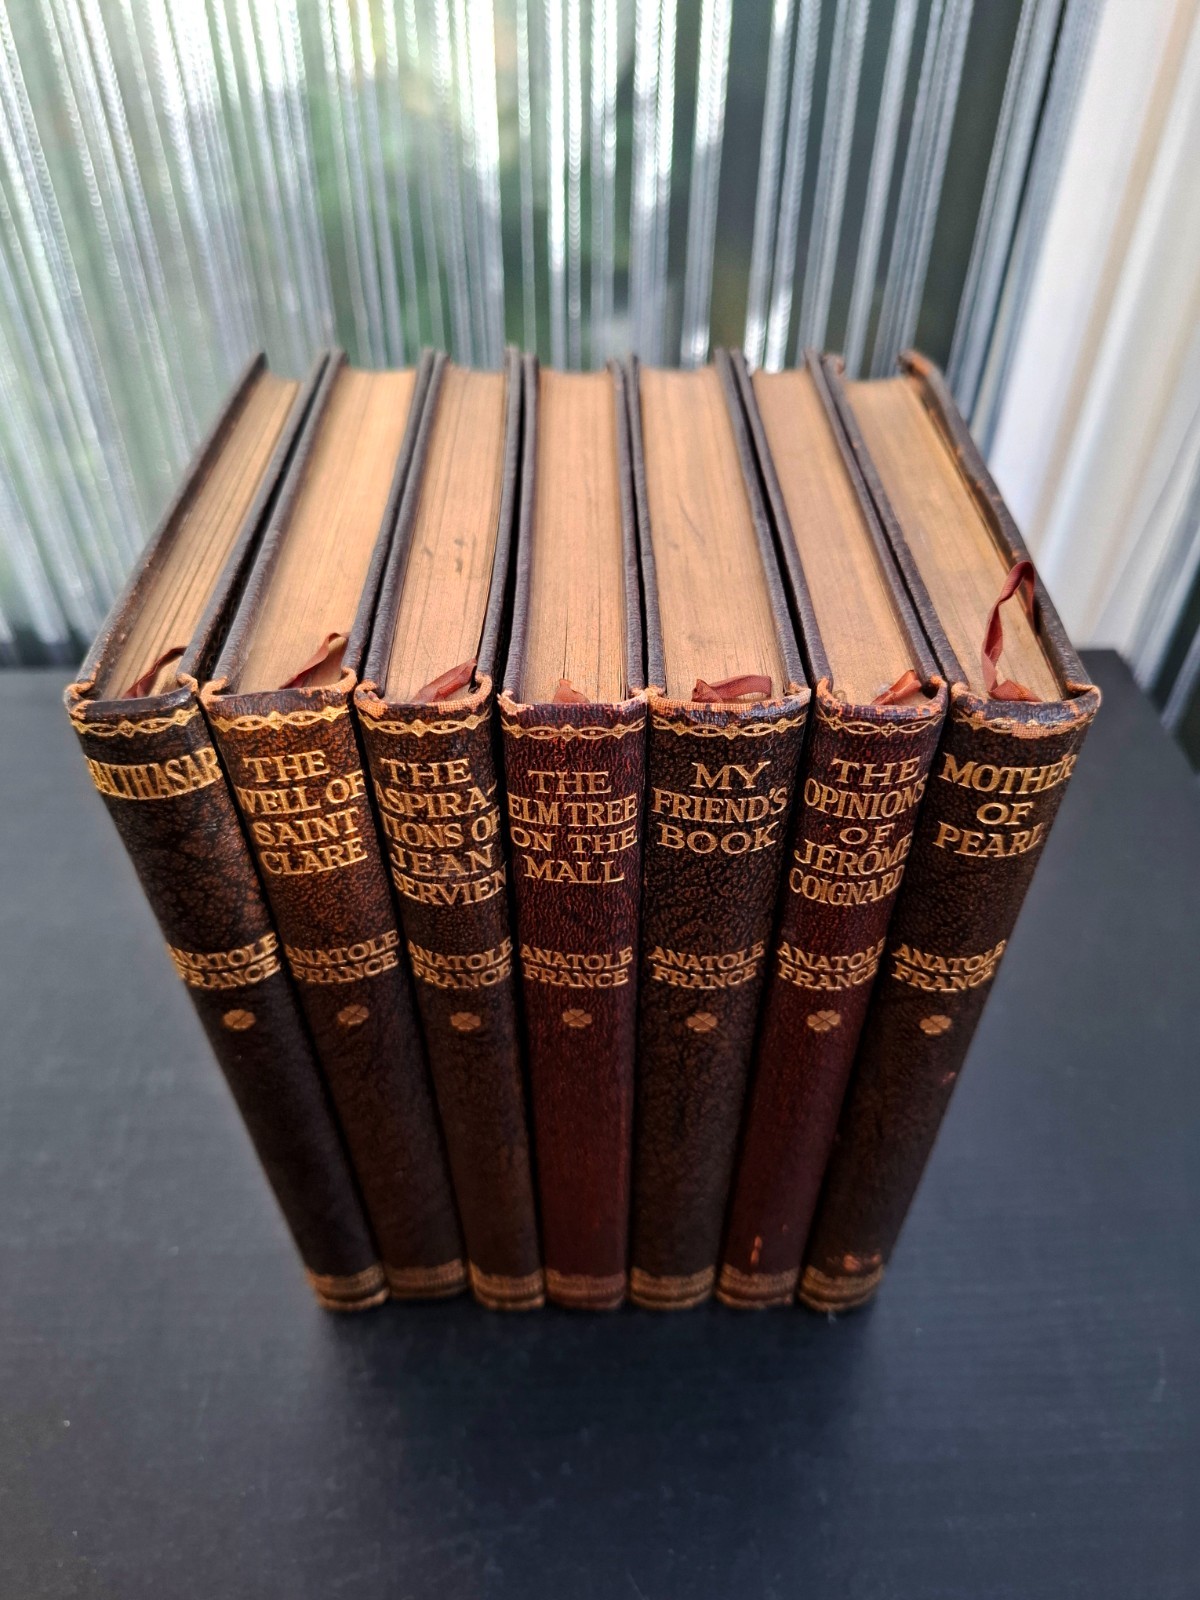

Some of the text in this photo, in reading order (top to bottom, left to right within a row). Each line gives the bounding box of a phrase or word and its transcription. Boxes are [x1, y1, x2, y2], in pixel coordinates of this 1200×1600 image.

[242, 749, 331, 783] THE
[380, 757, 472, 787] THE
[527, 769, 612, 795] THE
[689, 760, 772, 790] MY
[830, 755, 922, 786] THE
[937, 752, 1078, 795] MOTHER
[236, 769, 366, 816] WELL OF
[507, 791, 638, 827] ELM TREE
[651, 786, 788, 824] FRIEND'S
[803, 772, 929, 820] OPINIONS
[252, 806, 360, 846] SAINT
[470, 805, 500, 842] OF
[976, 801, 1035, 826] OF
[510, 824, 638, 854] ON THE
[656, 820, 780, 855] BOOK
[839, 822, 896, 845] OF
[931, 821, 1045, 858] PEARL
[260, 836, 369, 875] CLARE
[389, 843, 494, 878] JEAN
[522, 854, 625, 884] MALL
[788, 864, 906, 906] COIGNARD
[284, 930, 400, 966] ANATOLE
[407, 936, 514, 971] ANATOLE
[519, 943, 633, 971] ANATOLE
[647, 940, 765, 971] ANATOLE
[776, 936, 887, 972] ANATOLE
[891, 939, 1008, 974] ANATOLE
[289, 951, 400, 984] FRANCE
[411, 956, 513, 989] FRANCE
[523, 962, 630, 989] FRANCE
[651, 960, 758, 990] FRANCE
[777, 958, 879, 991] FRANCE
